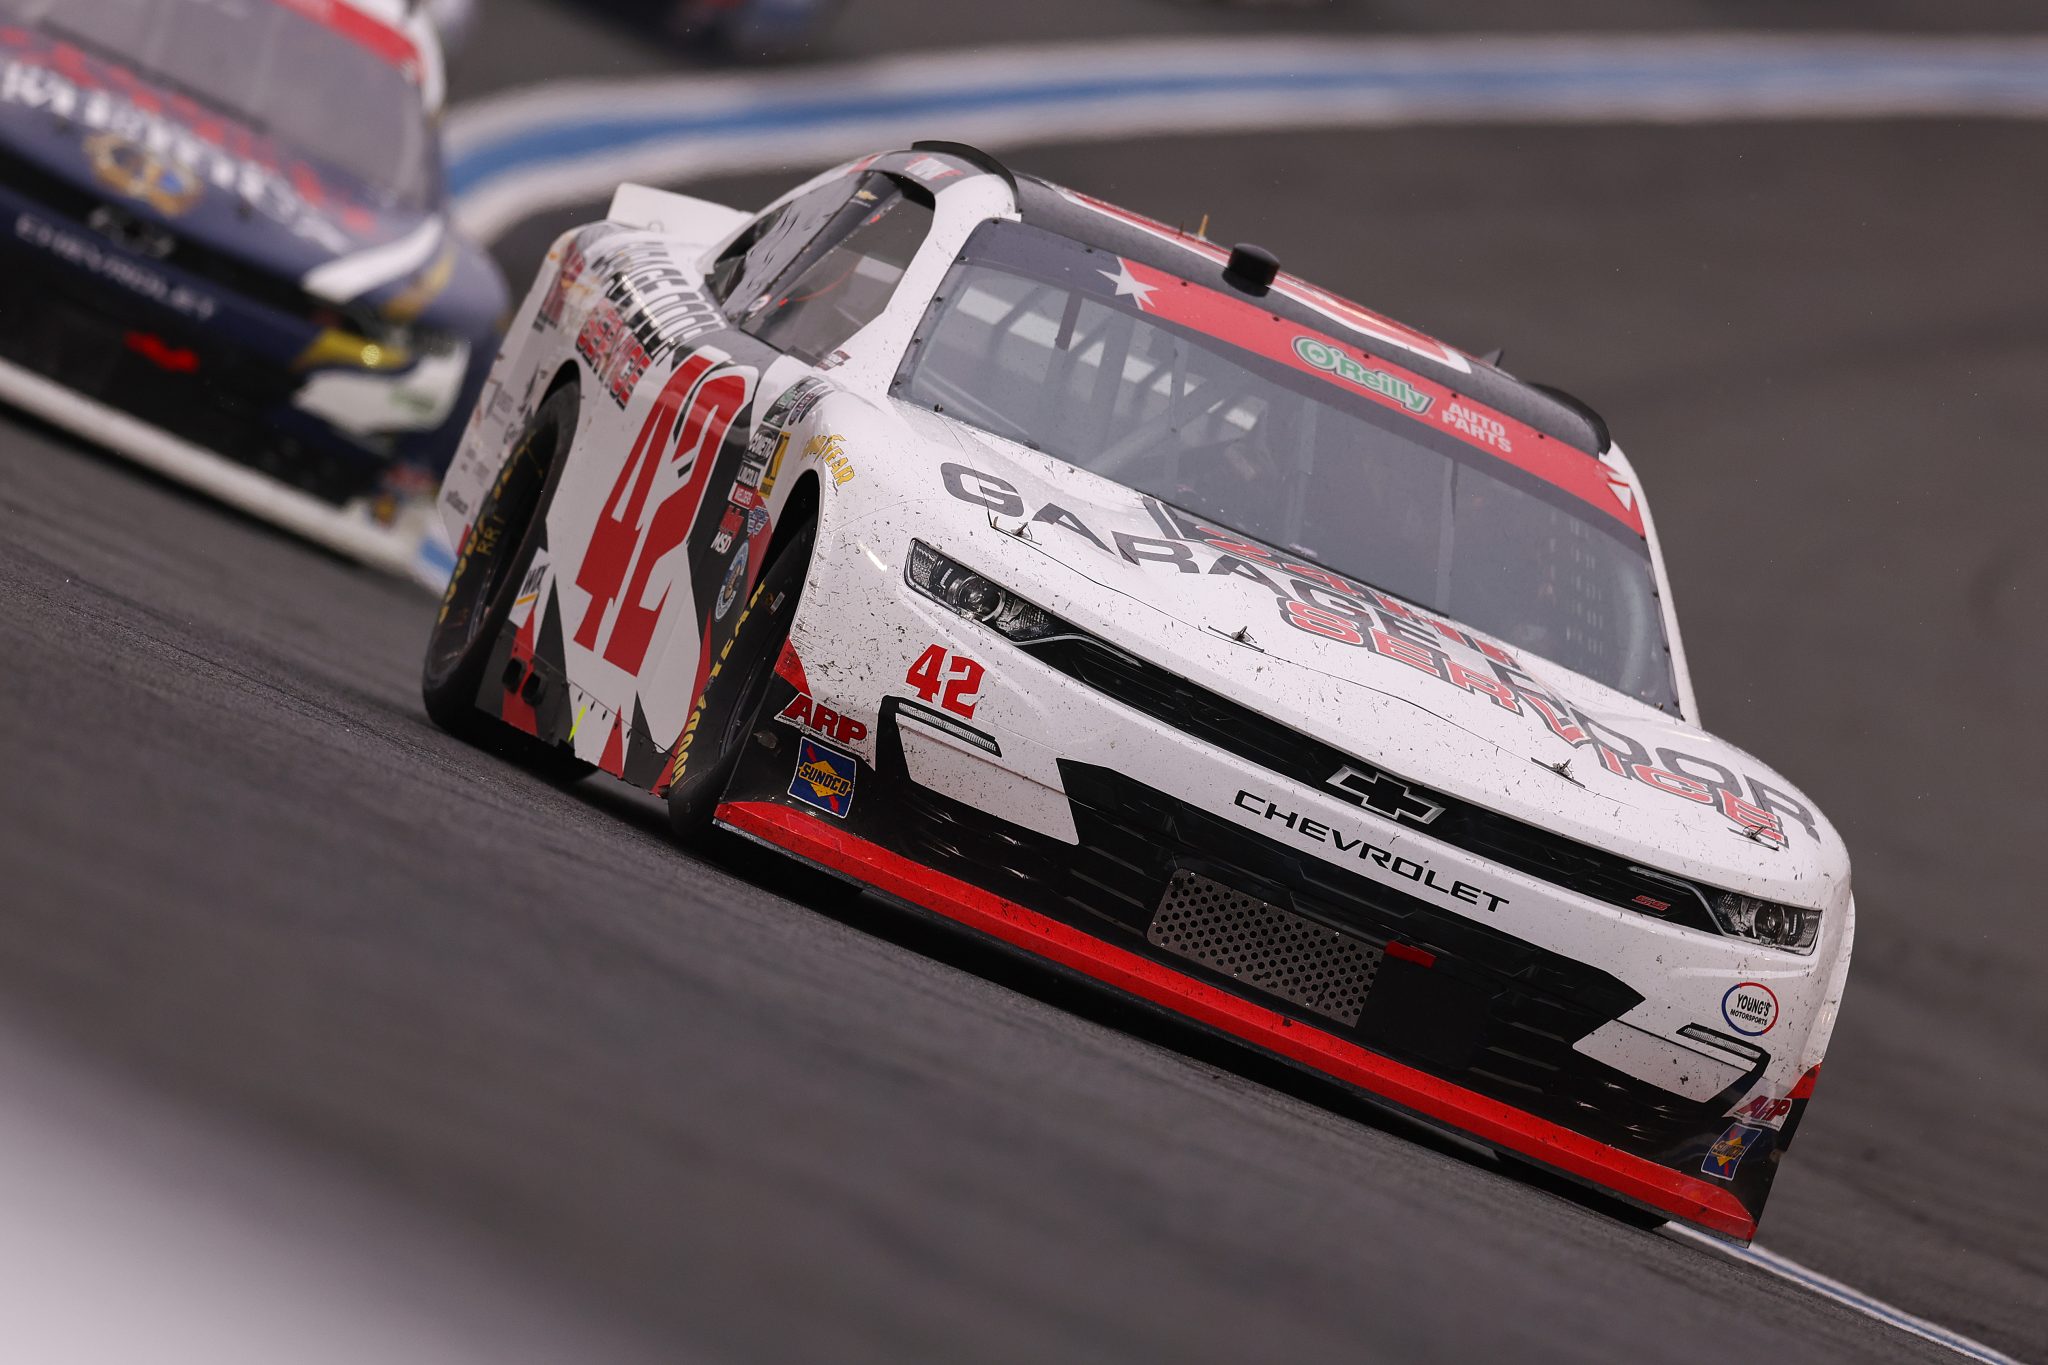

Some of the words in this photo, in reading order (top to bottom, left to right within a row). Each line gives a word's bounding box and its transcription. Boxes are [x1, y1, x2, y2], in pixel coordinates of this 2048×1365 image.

[1296, 338, 1428, 412] O'Reilly
[1441, 410, 1513, 454] PARTS
[1448, 402, 1506, 437] AUTO
[573, 353, 747, 678] 42
[710, 532, 733, 555] MSD
[941, 461, 1452, 664] GARAGE
[1485, 657, 1822, 845] DOOR
[905, 643, 985, 720] 42
[780, 695, 867, 744] ARP
[1278, 598, 1788, 847] SERVICE
[800, 763, 850, 794] SUNOCO
[1234, 789, 1510, 915] CHEVROLET
[1729, 1008, 1768, 1027] MOTORSPORTS
[1736, 993, 1772, 1017] YOUNG'S
[1736, 1095, 1791, 1122] ARP
